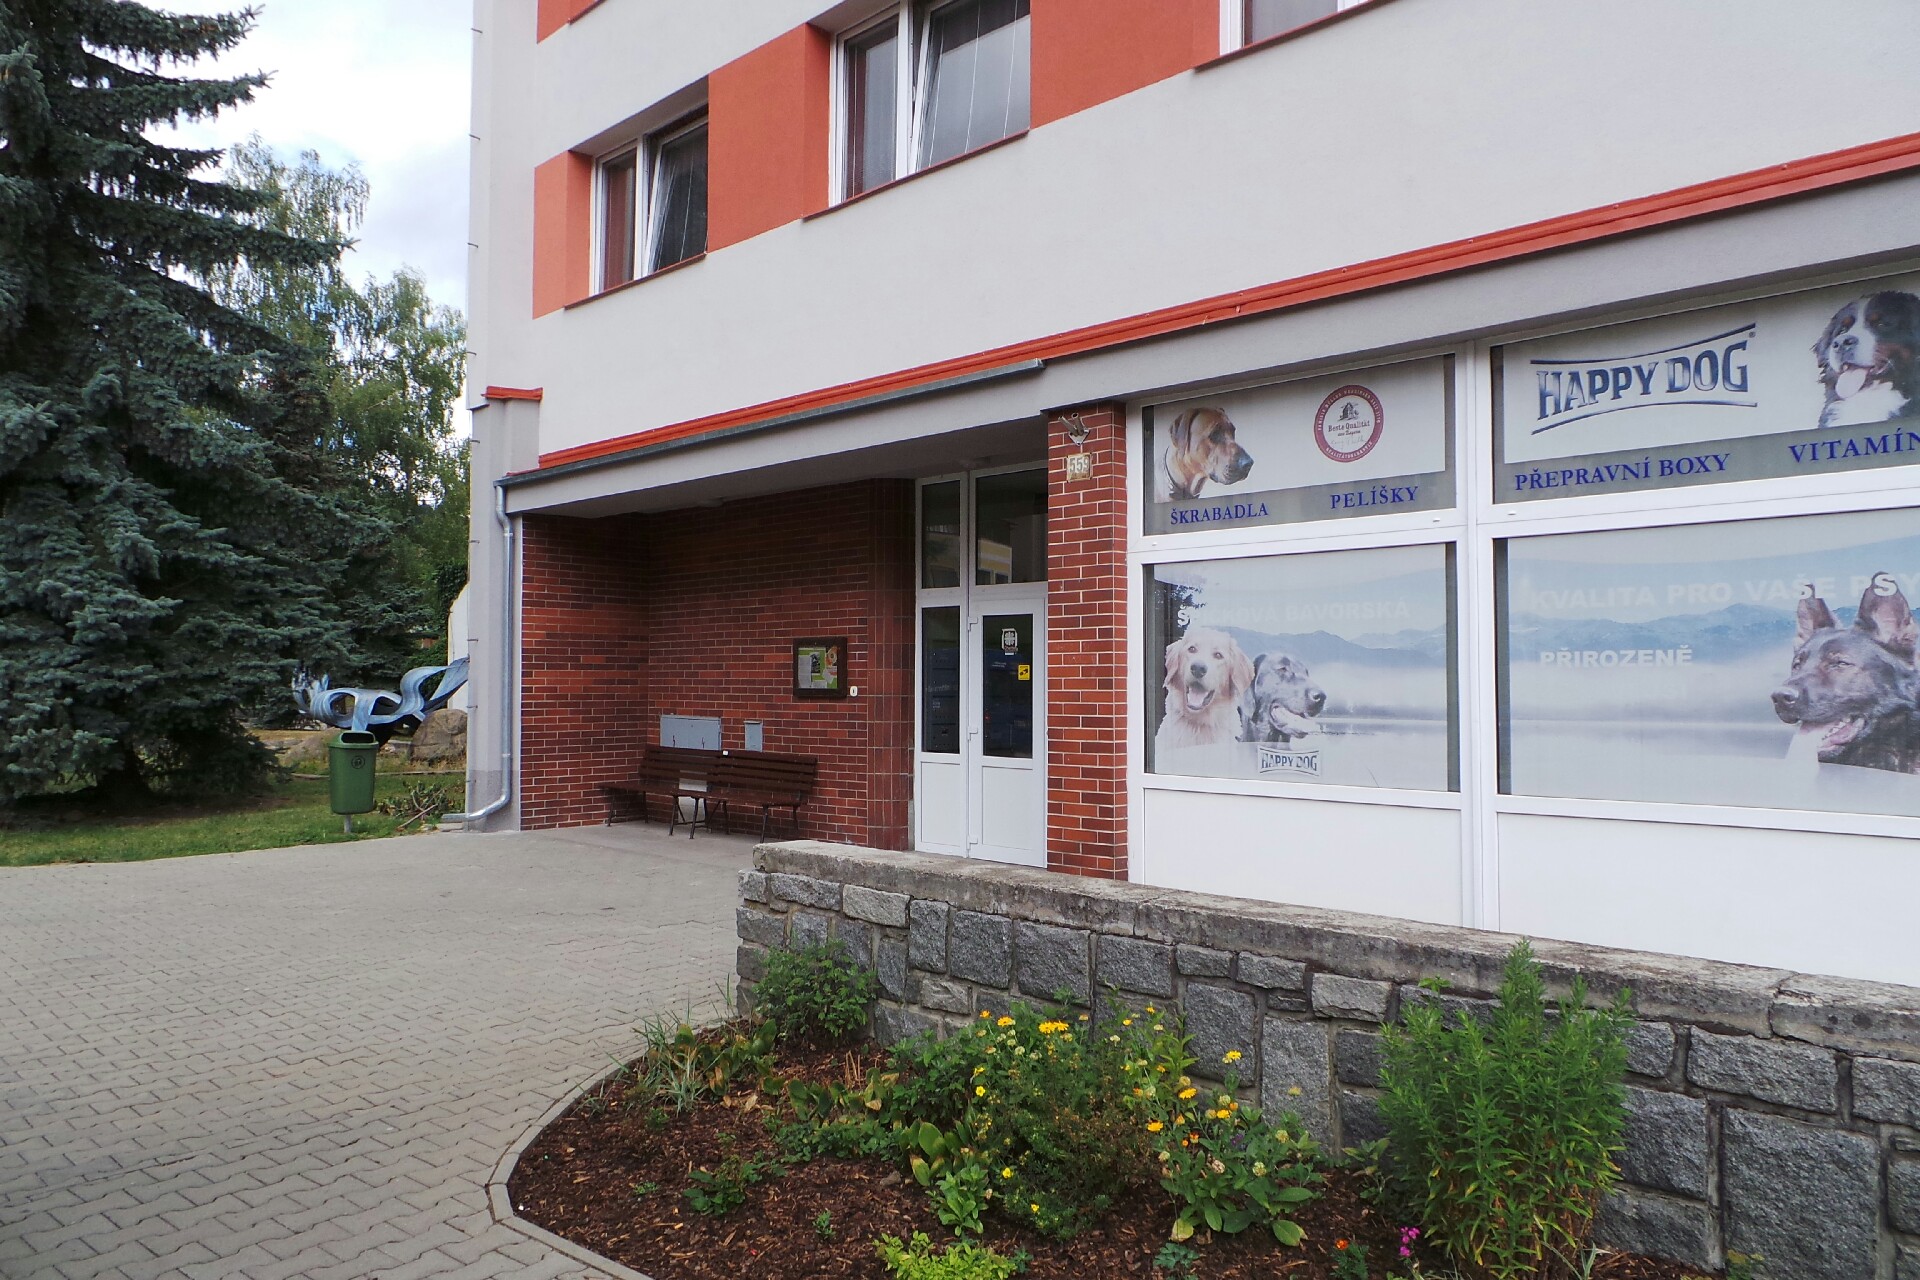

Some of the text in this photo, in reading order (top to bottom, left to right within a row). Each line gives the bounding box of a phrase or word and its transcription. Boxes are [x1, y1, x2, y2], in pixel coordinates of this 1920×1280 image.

[1535, 339, 1749, 421] HAPPY DOG
[1328, 424, 1345, 433] Beste
[1515, 453, 1731, 491] PŘEPRAVNÍ BOXY
[1330, 485, 1419, 510] PELÍŠKY
[1170, 502, 1269, 525] ŠKRABADLA
[1530, 572, 1920, 611] KVALITA PRO VAŠE PSY
[1539, 644, 1694, 669] PŘIROZENĚ
[1261, 752, 1318, 772] HAPPY DOG
